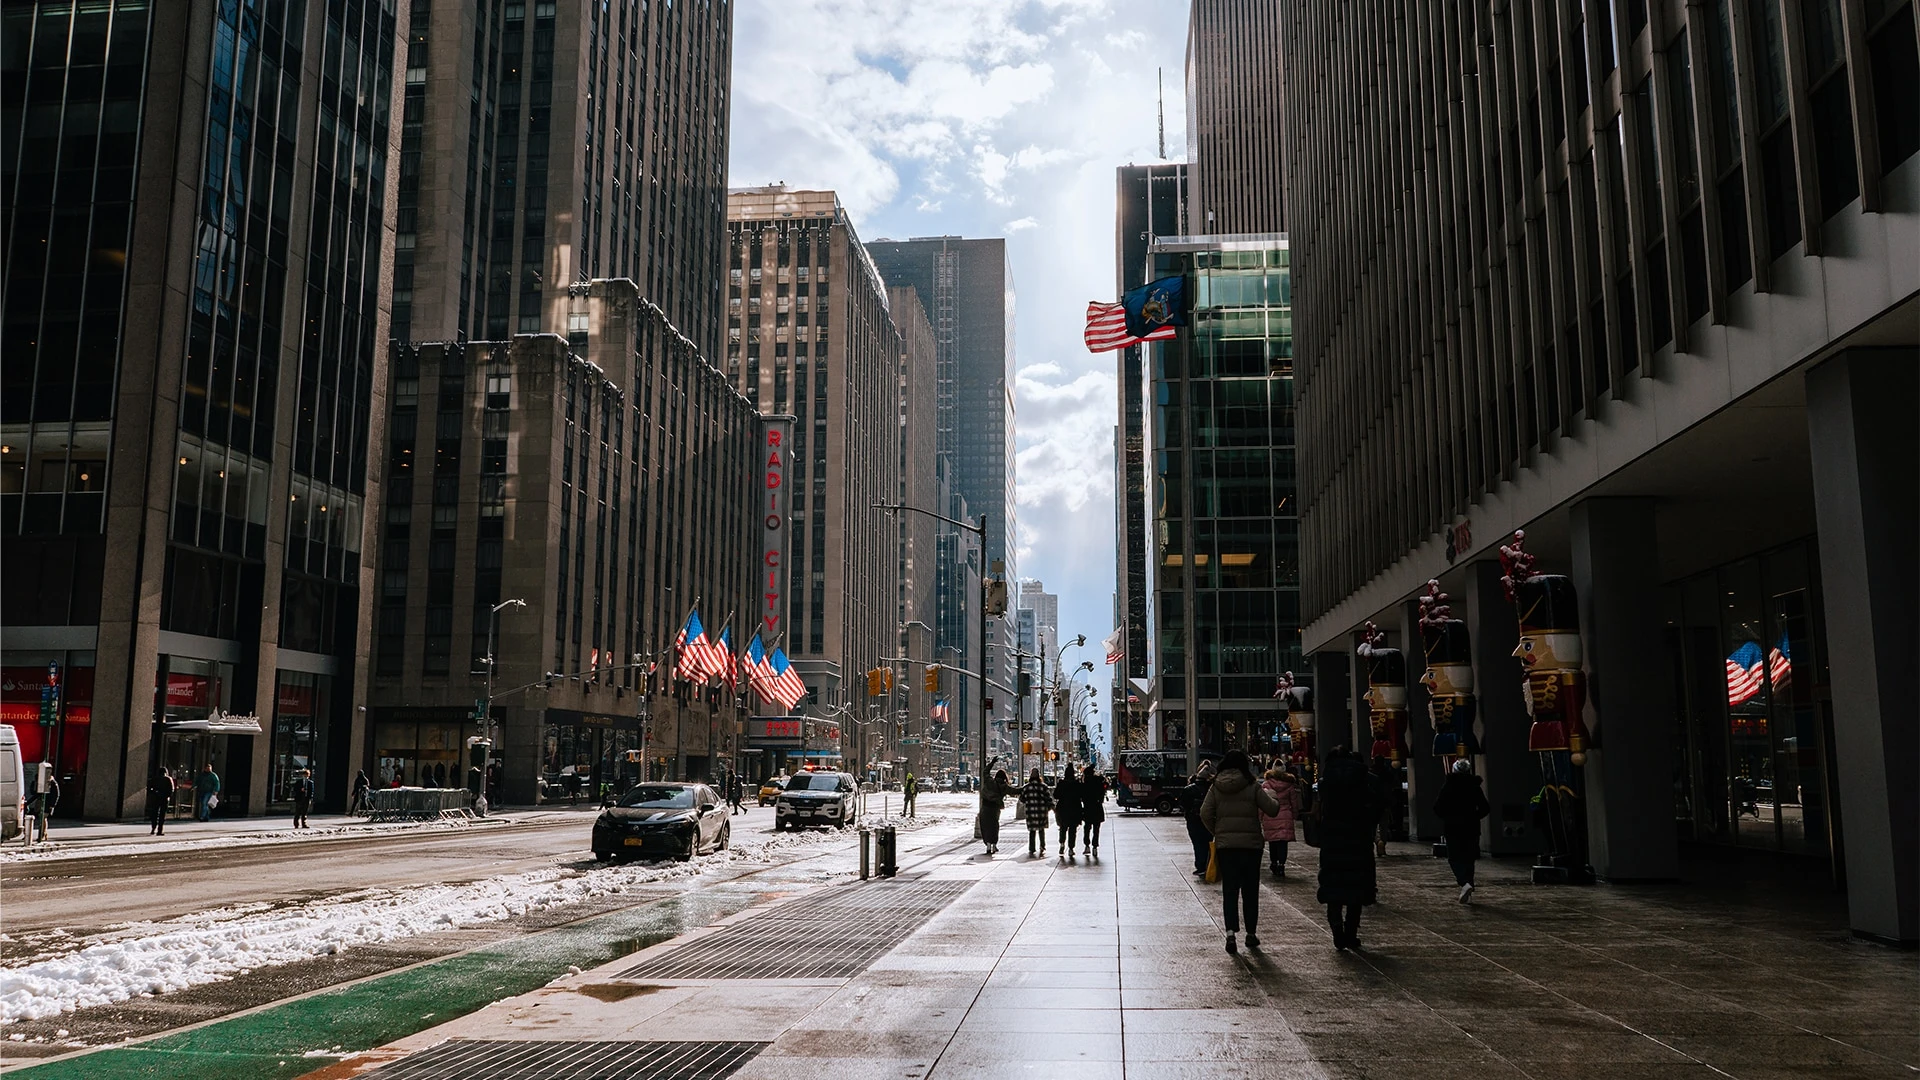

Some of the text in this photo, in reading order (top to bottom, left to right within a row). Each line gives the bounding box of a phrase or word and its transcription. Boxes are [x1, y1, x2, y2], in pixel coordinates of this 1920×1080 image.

[763, 430, 782, 632] RADIO CITY
[17, 680, 43, 691] Santa
[167, 685, 194, 697] antander
[0, 710, 40, 720] ntander
[65, 712, 90, 722] Santand
[220, 710, 260, 723] Santander
